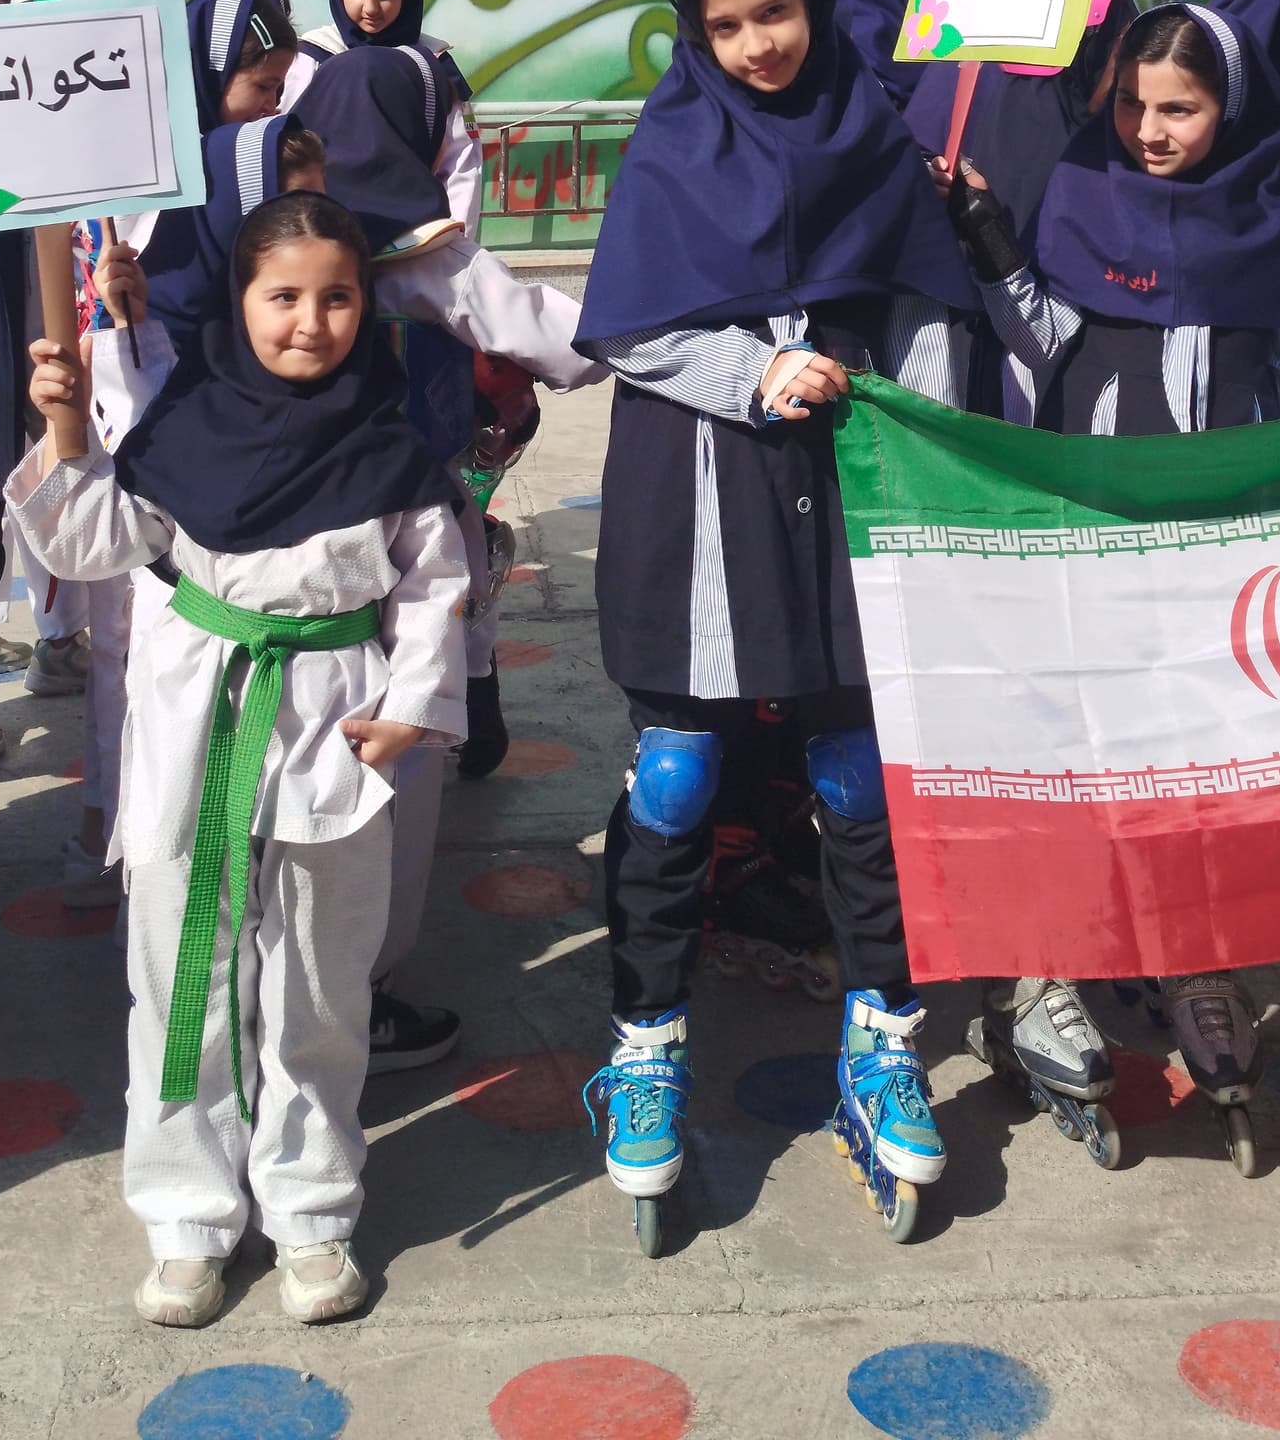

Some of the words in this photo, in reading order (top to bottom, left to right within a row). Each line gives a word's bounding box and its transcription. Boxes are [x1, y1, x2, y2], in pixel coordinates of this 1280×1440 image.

[615, 1050, 645, 1062] SPORTS
[1034, 1039, 1052, 1056] FILA
[879, 1054, 924, 1073] SPORT
